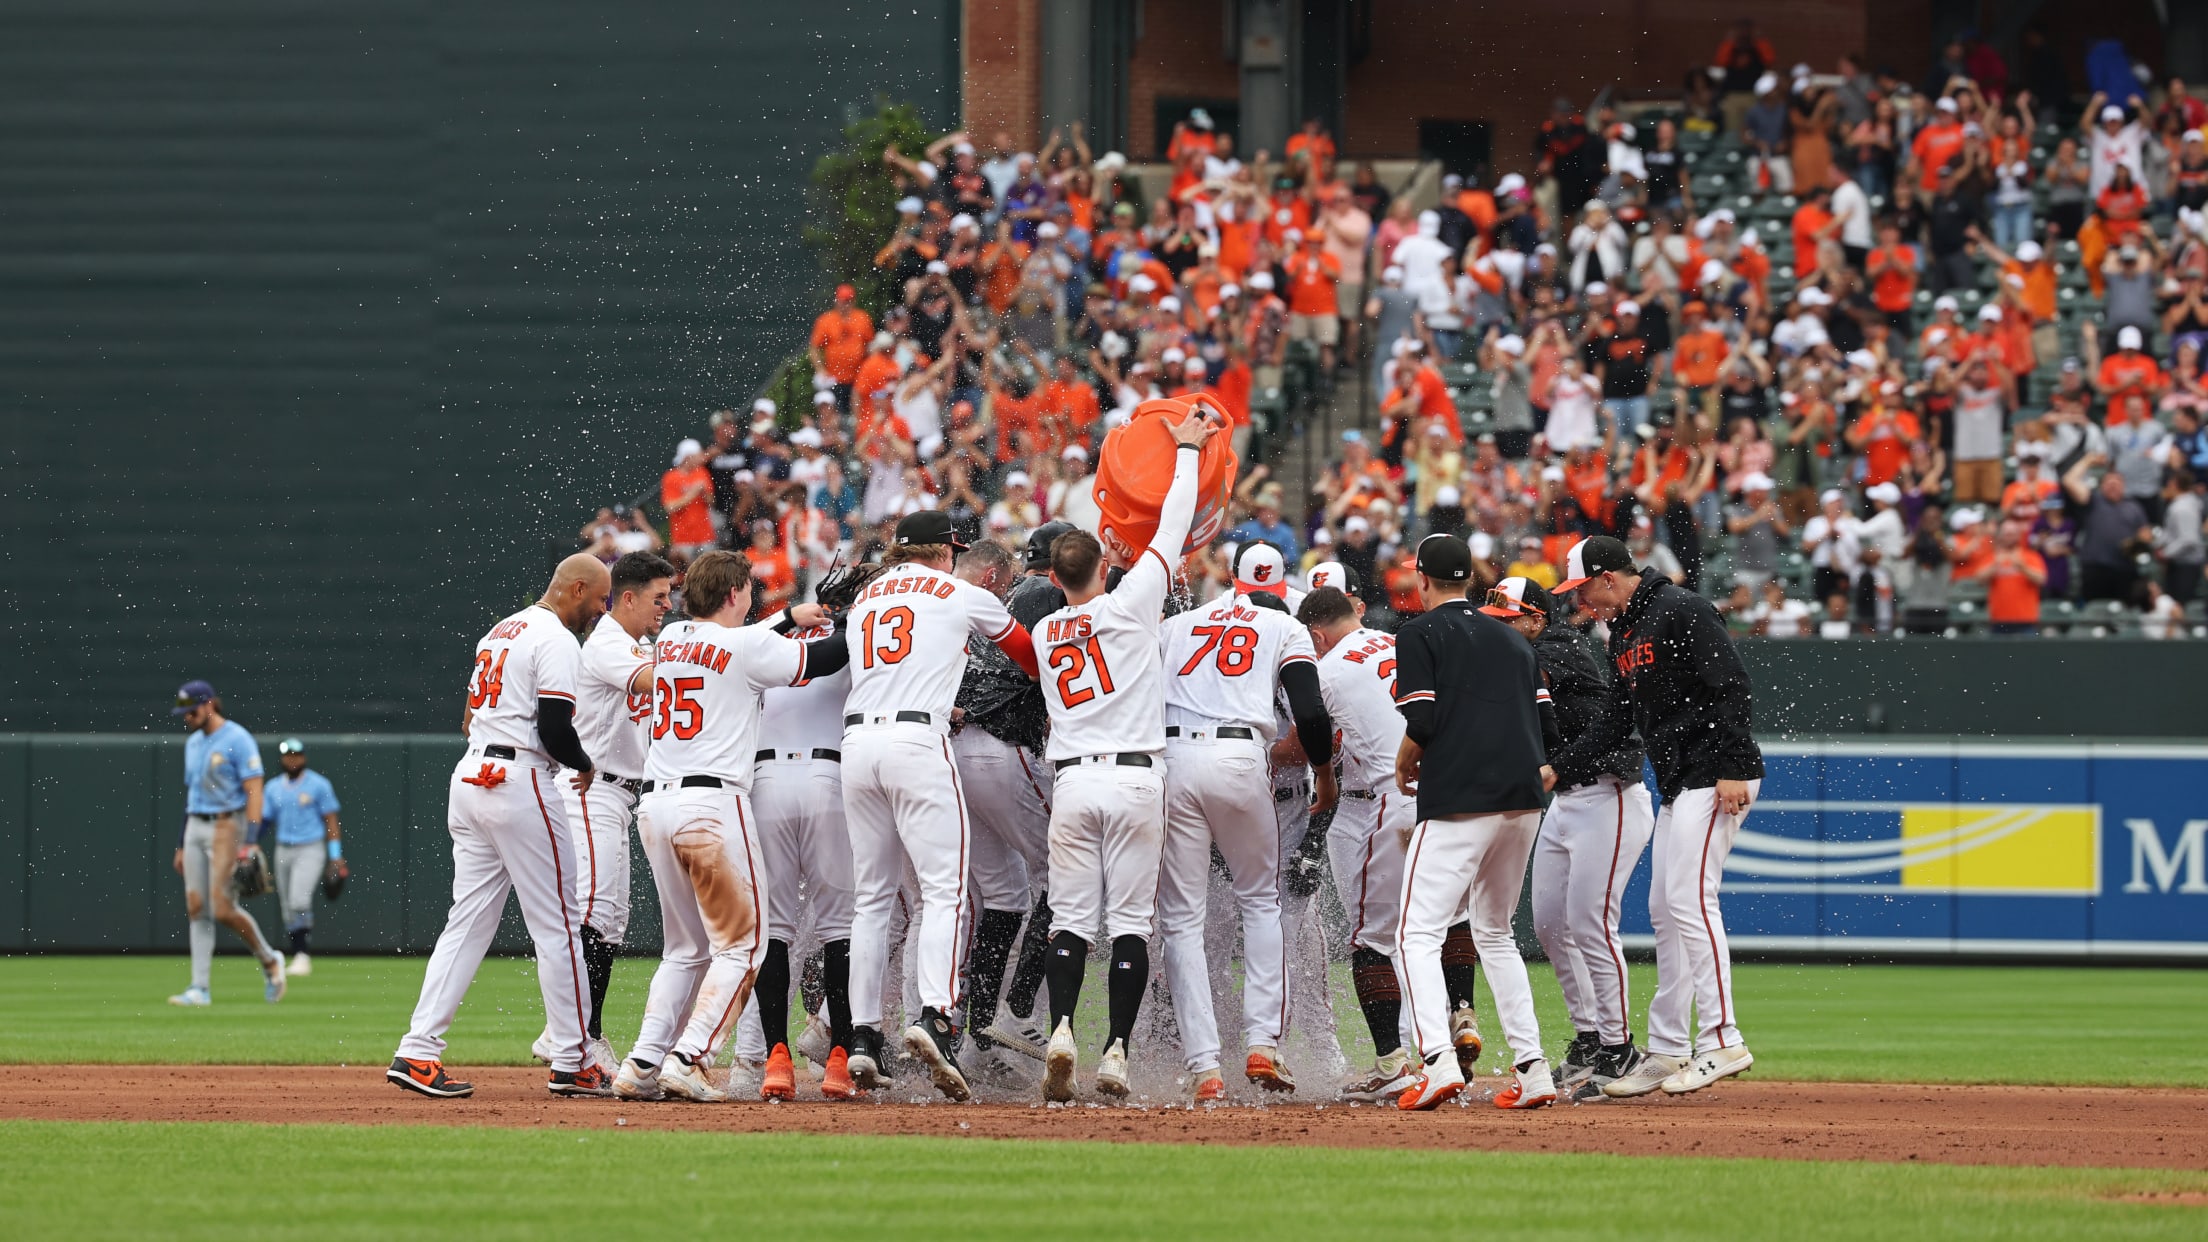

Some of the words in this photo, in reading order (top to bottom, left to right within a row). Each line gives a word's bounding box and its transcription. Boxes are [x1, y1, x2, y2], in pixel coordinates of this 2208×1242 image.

[851, 577, 956, 608] JERSTAD
[1208, 604, 1259, 622] CANO
[861, 605, 915, 669] 13
[1046, 613, 1093, 643] HAYS
[1177, 625, 1260, 676] 78
[469, 648, 510, 709] 34
[654, 640, 733, 675] TSCHMAN
[1048, 634, 1116, 710] 21
[652, 676, 704, 740] 35
[2121, 818, 2208, 893] M
